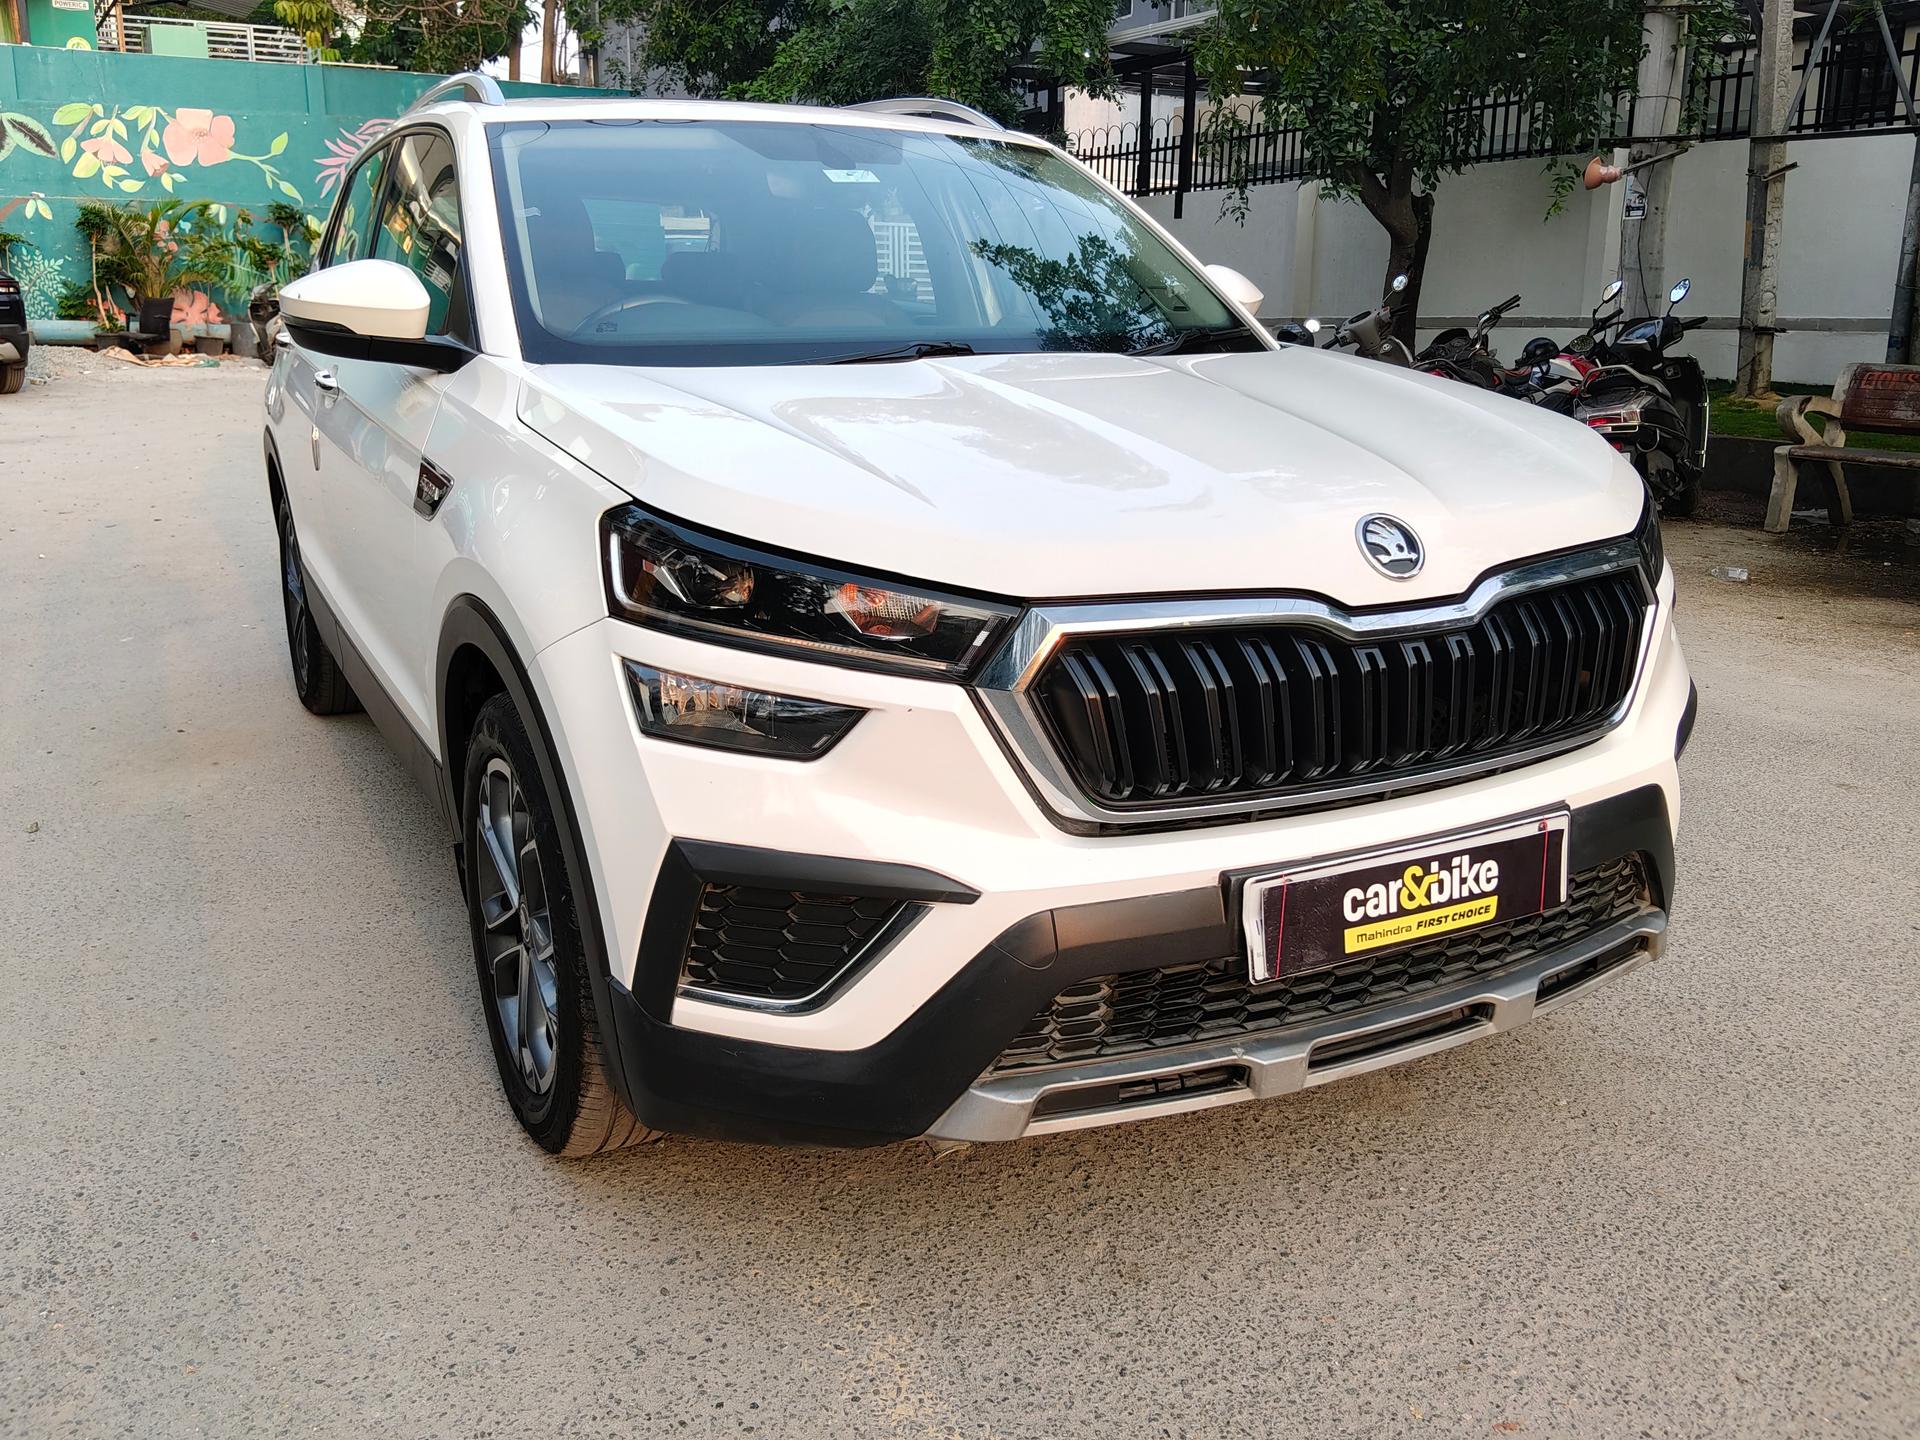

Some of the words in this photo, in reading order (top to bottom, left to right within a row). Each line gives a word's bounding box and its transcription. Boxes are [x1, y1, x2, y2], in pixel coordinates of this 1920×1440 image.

[1343, 854, 1499, 922] car&bike
[1356, 925, 1412, 943] Mahindra
[1416, 914, 1450, 930] FIRST
[1451, 904, 1491, 922] CHOICE
